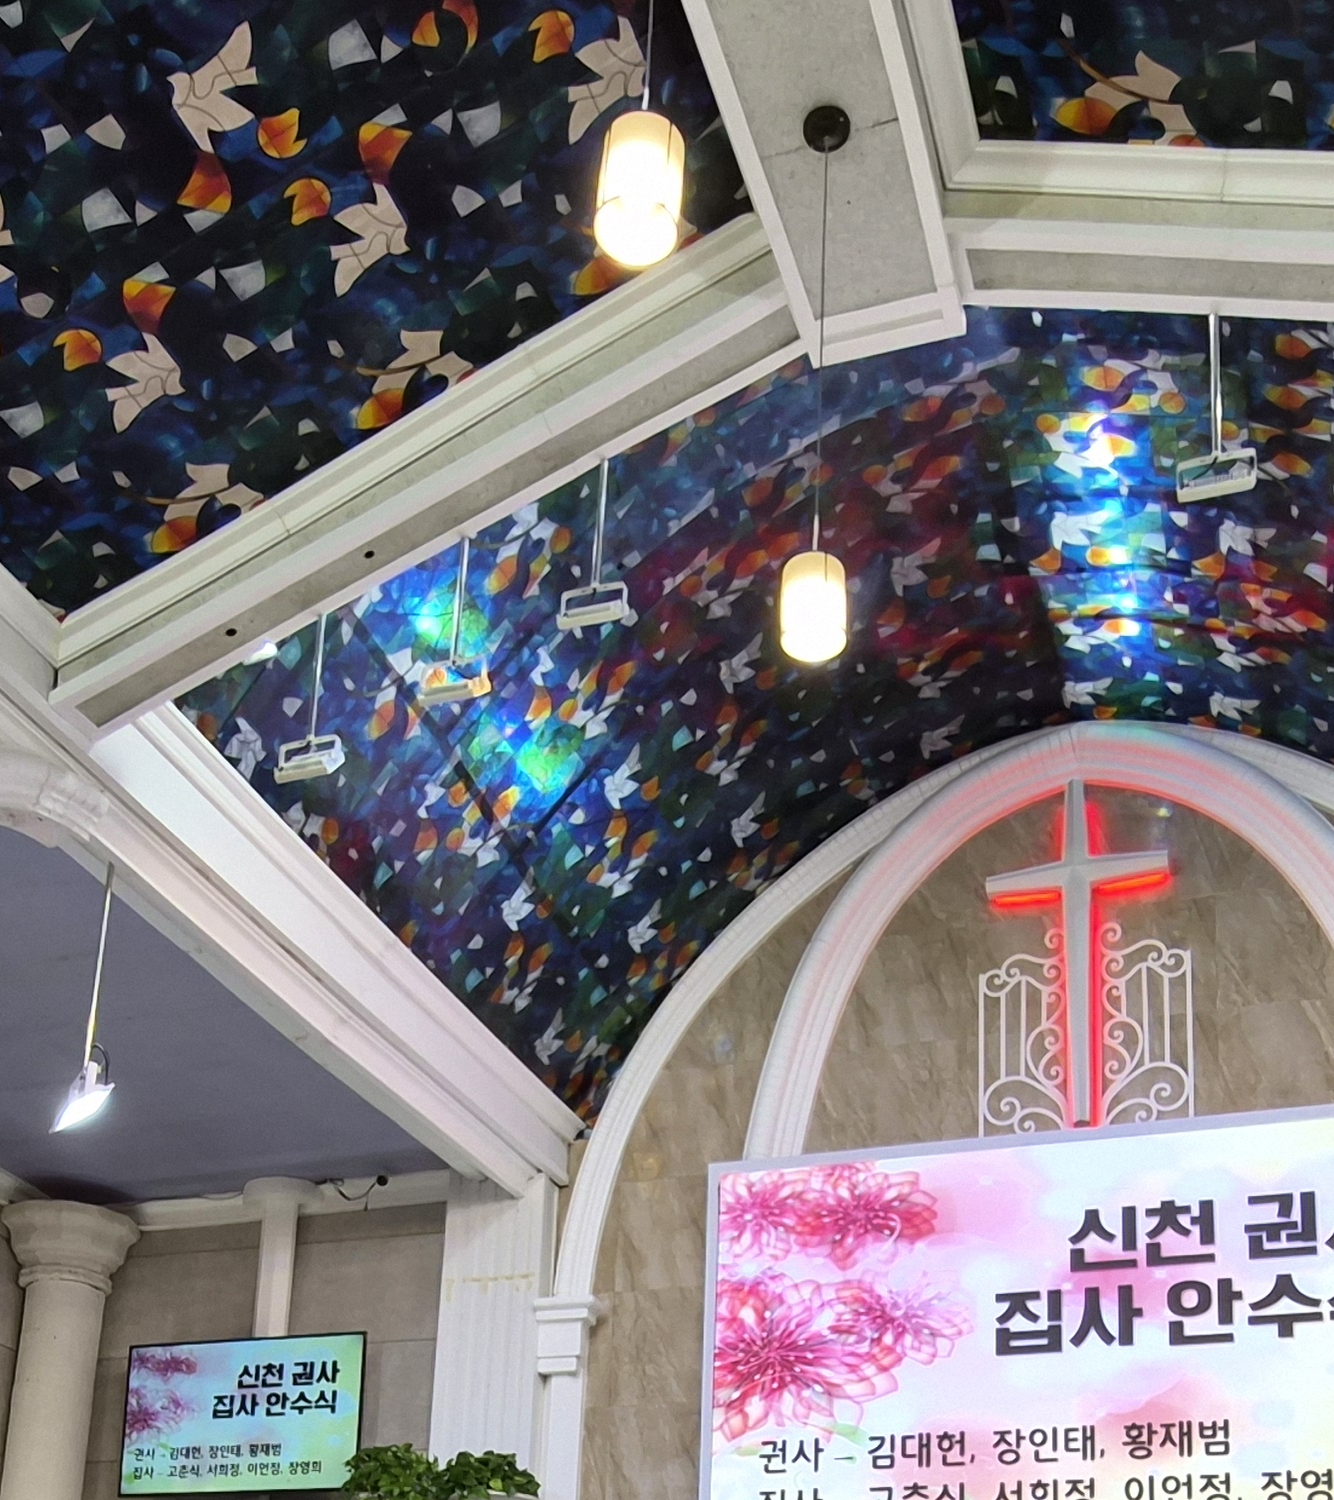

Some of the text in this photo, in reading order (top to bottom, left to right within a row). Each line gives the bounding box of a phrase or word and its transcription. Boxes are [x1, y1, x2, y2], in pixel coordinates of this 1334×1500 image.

[1067, 1199, 1216, 1272] 신천
[995, 1284, 1144, 1356] 집사
[237, 1360, 341, 1389] 신천 권사
[212, 1389, 338, 1419] 집사 안수식
[758, 1437, 825, 1474] 권사
[867, 1430, 976, 1470] 김대헌,
[991, 1424, 1105, 1466] 장인태,
[1122, 1419, 1230, 1459] 황재범
[133, 1466, 154, 1481] 집사
